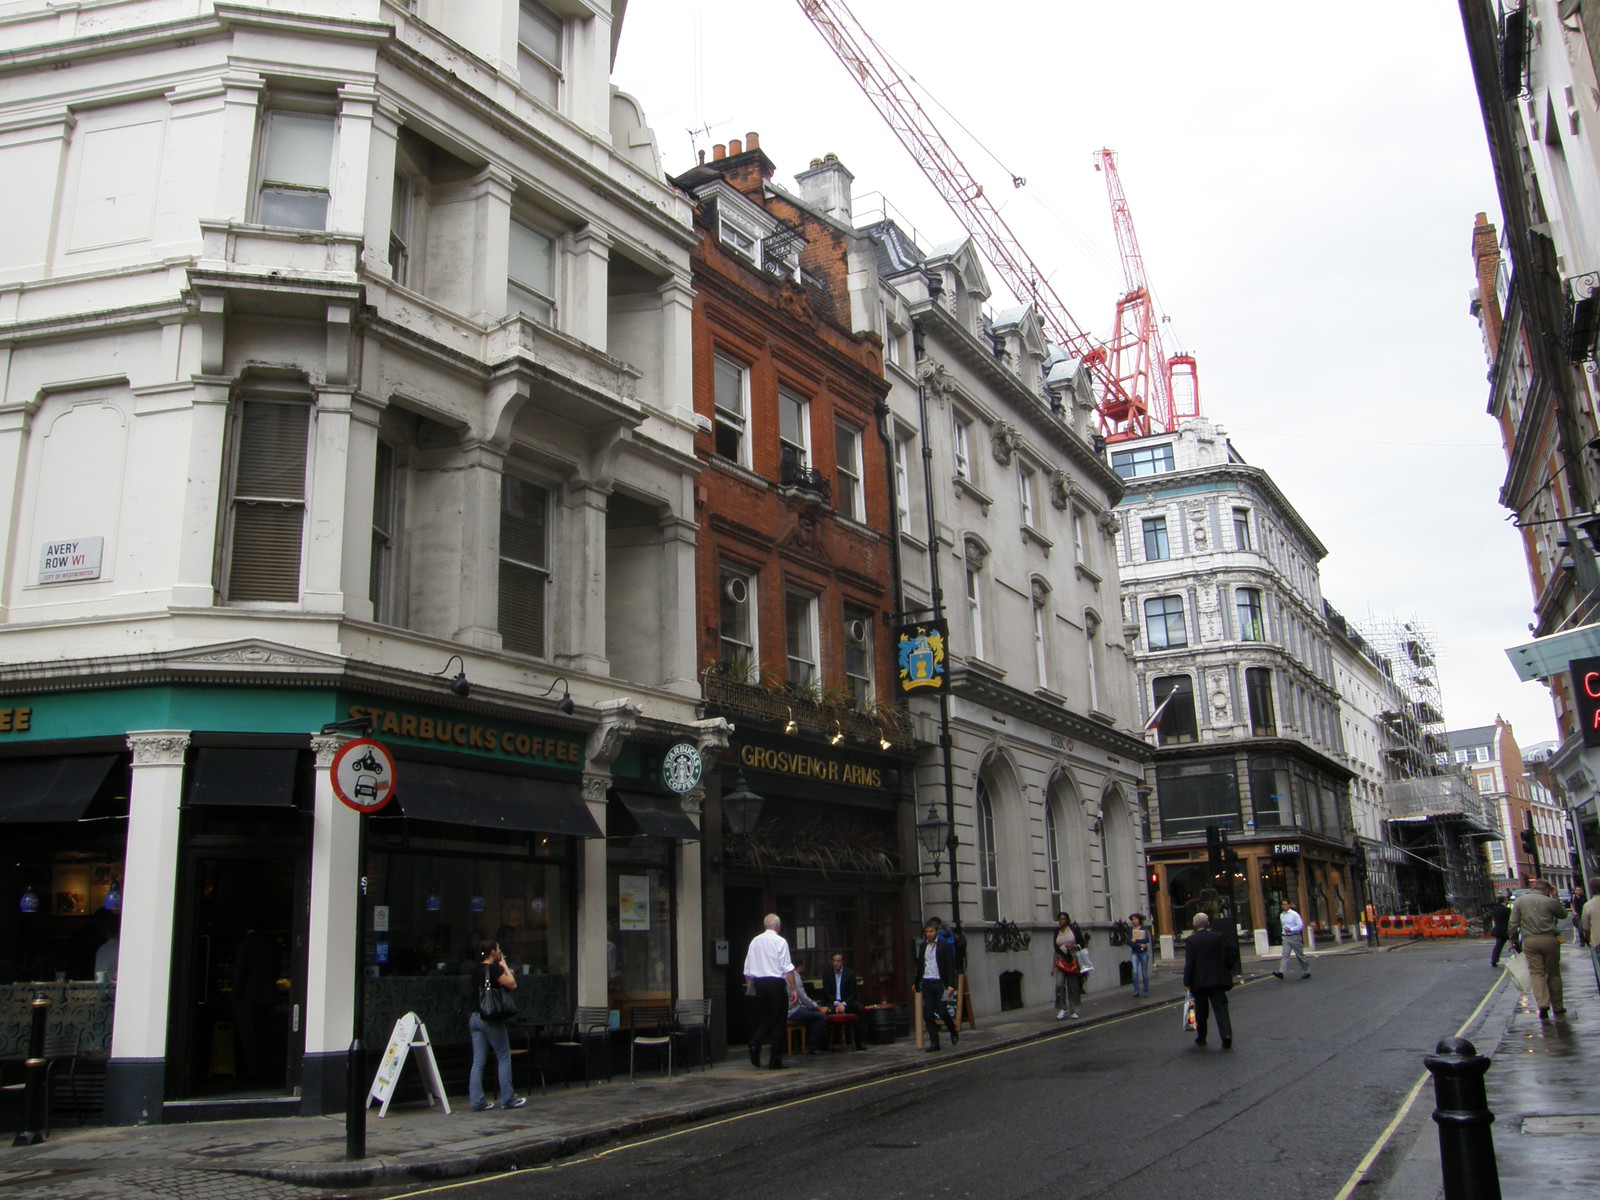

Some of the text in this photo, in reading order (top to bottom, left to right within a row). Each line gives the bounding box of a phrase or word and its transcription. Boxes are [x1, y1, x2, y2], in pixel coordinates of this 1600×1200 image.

[46, 542, 79, 556] AVERY
[45, 555, 85, 569] ROW W1
[62, 570, 94, 578] WESTMINSTER
[350, 705, 579, 763] STARBUCKS COFFEE
[1050, 732, 1066, 751] HSBC
[664, 745, 700, 791] STARBUCKS COFFEE
[842, 763, 881, 787] ARMS
[1281, 844, 1300, 853] PINET
